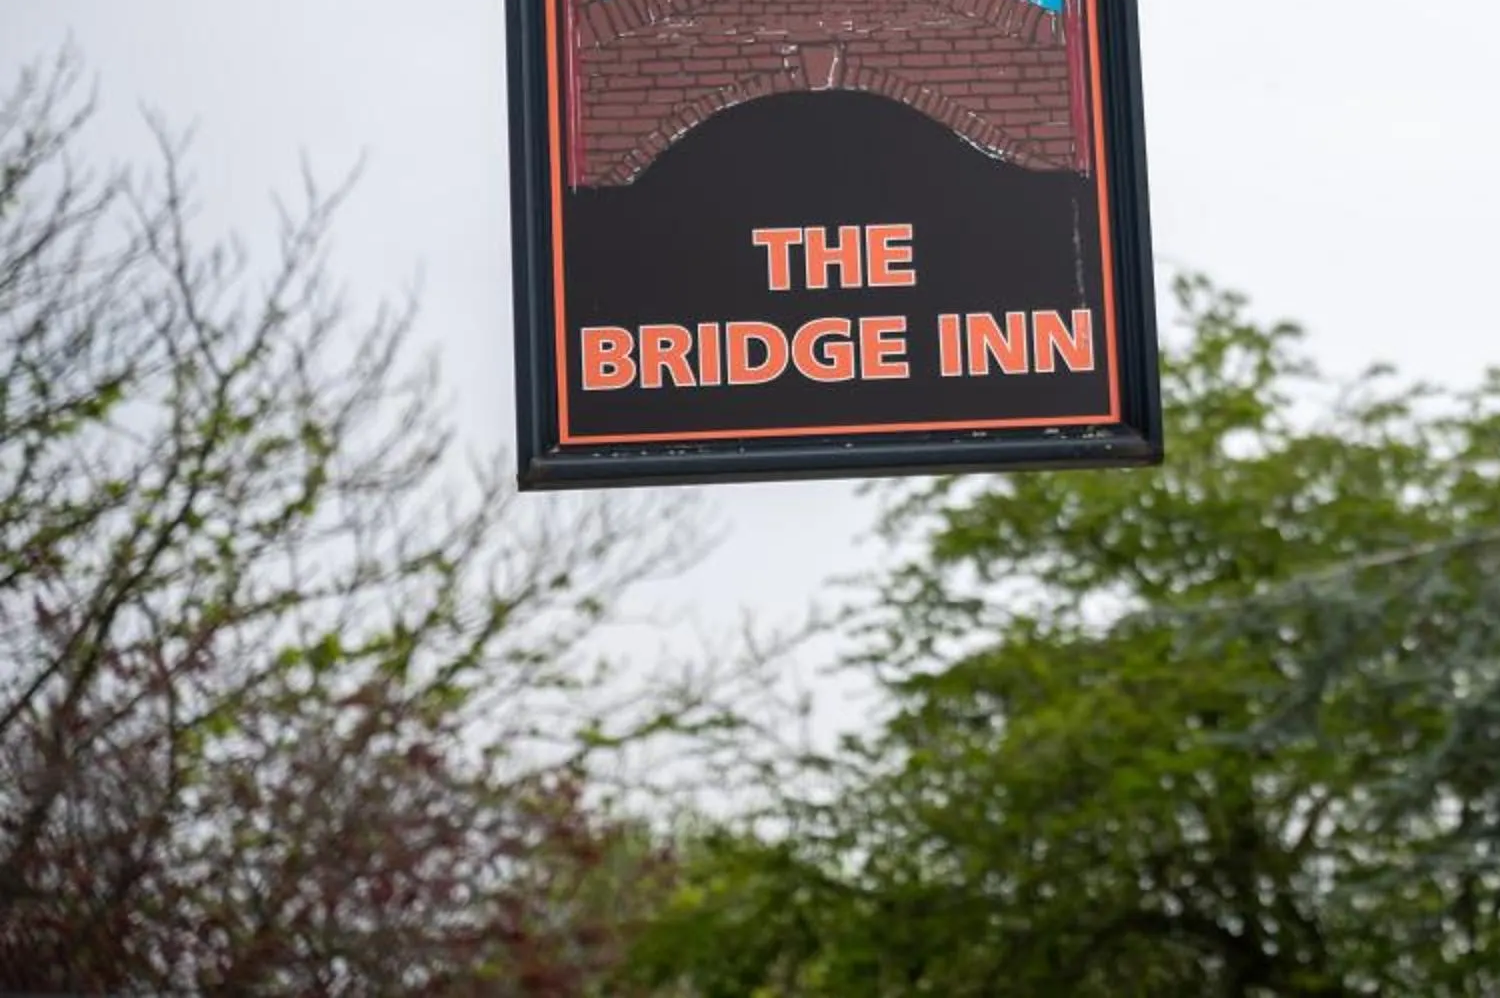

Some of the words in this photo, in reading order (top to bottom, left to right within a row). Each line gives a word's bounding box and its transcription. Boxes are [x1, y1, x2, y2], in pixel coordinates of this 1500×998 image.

[752, 224, 916, 290] THE
[580, 316, 910, 390] BRIDGE
[938, 309, 1095, 377] INN
